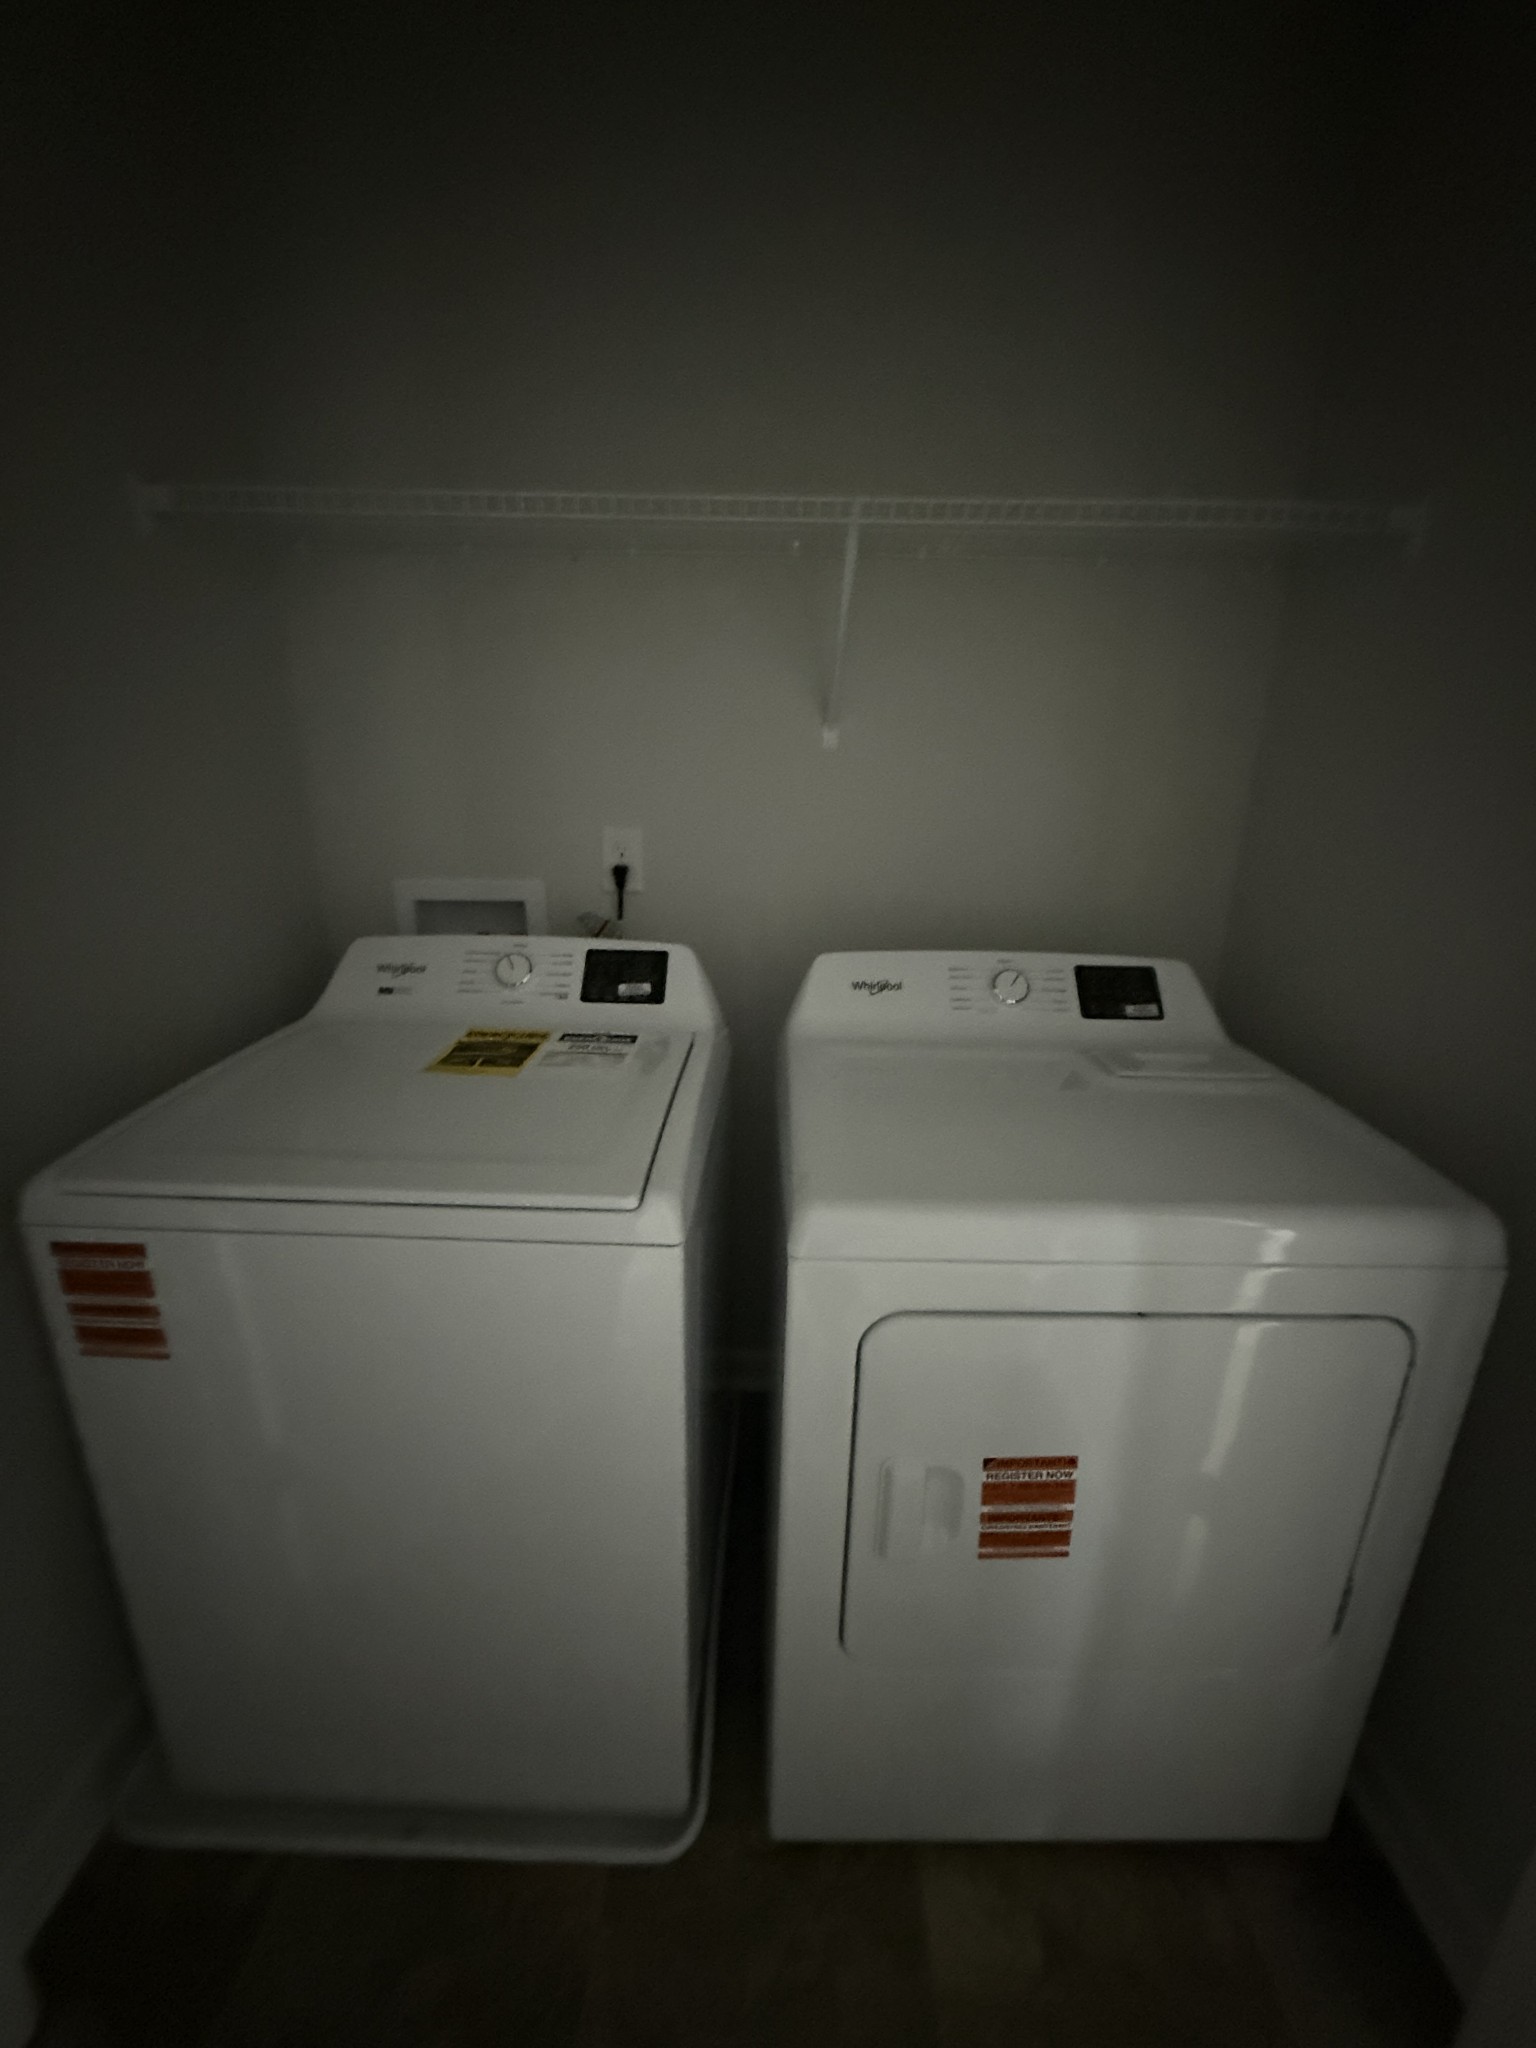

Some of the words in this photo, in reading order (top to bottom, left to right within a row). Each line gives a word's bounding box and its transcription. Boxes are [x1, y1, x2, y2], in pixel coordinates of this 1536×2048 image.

[851, 980, 902, 995] Whirlpool
[986, 1471, 1043, 1480] REGISTER
[1046, 1470, 1074, 1479] NOW
